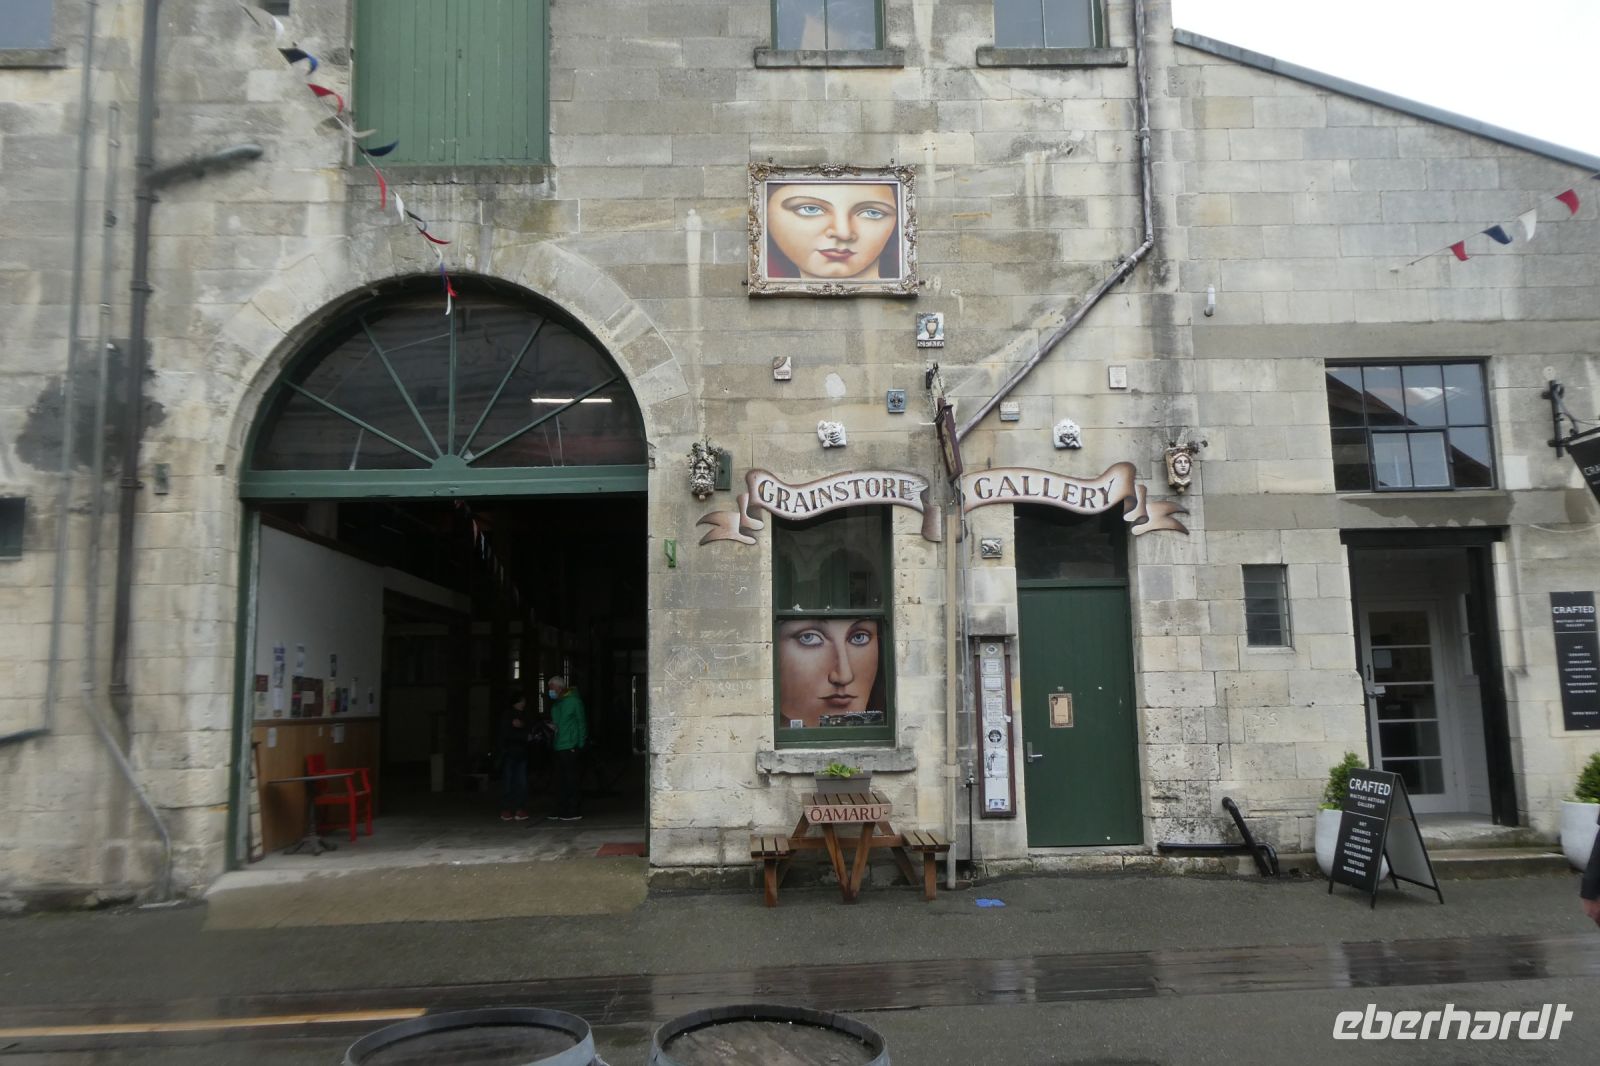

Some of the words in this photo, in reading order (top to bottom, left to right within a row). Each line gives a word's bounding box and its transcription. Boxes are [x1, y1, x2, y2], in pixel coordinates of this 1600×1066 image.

[758, 477, 915, 513] GRAINSTORE
[974, 475, 1115, 509] GALLERY
[1552, 605, 1595, 614] CRAFTED
[1349, 778, 1391, 796] CRAFTED
